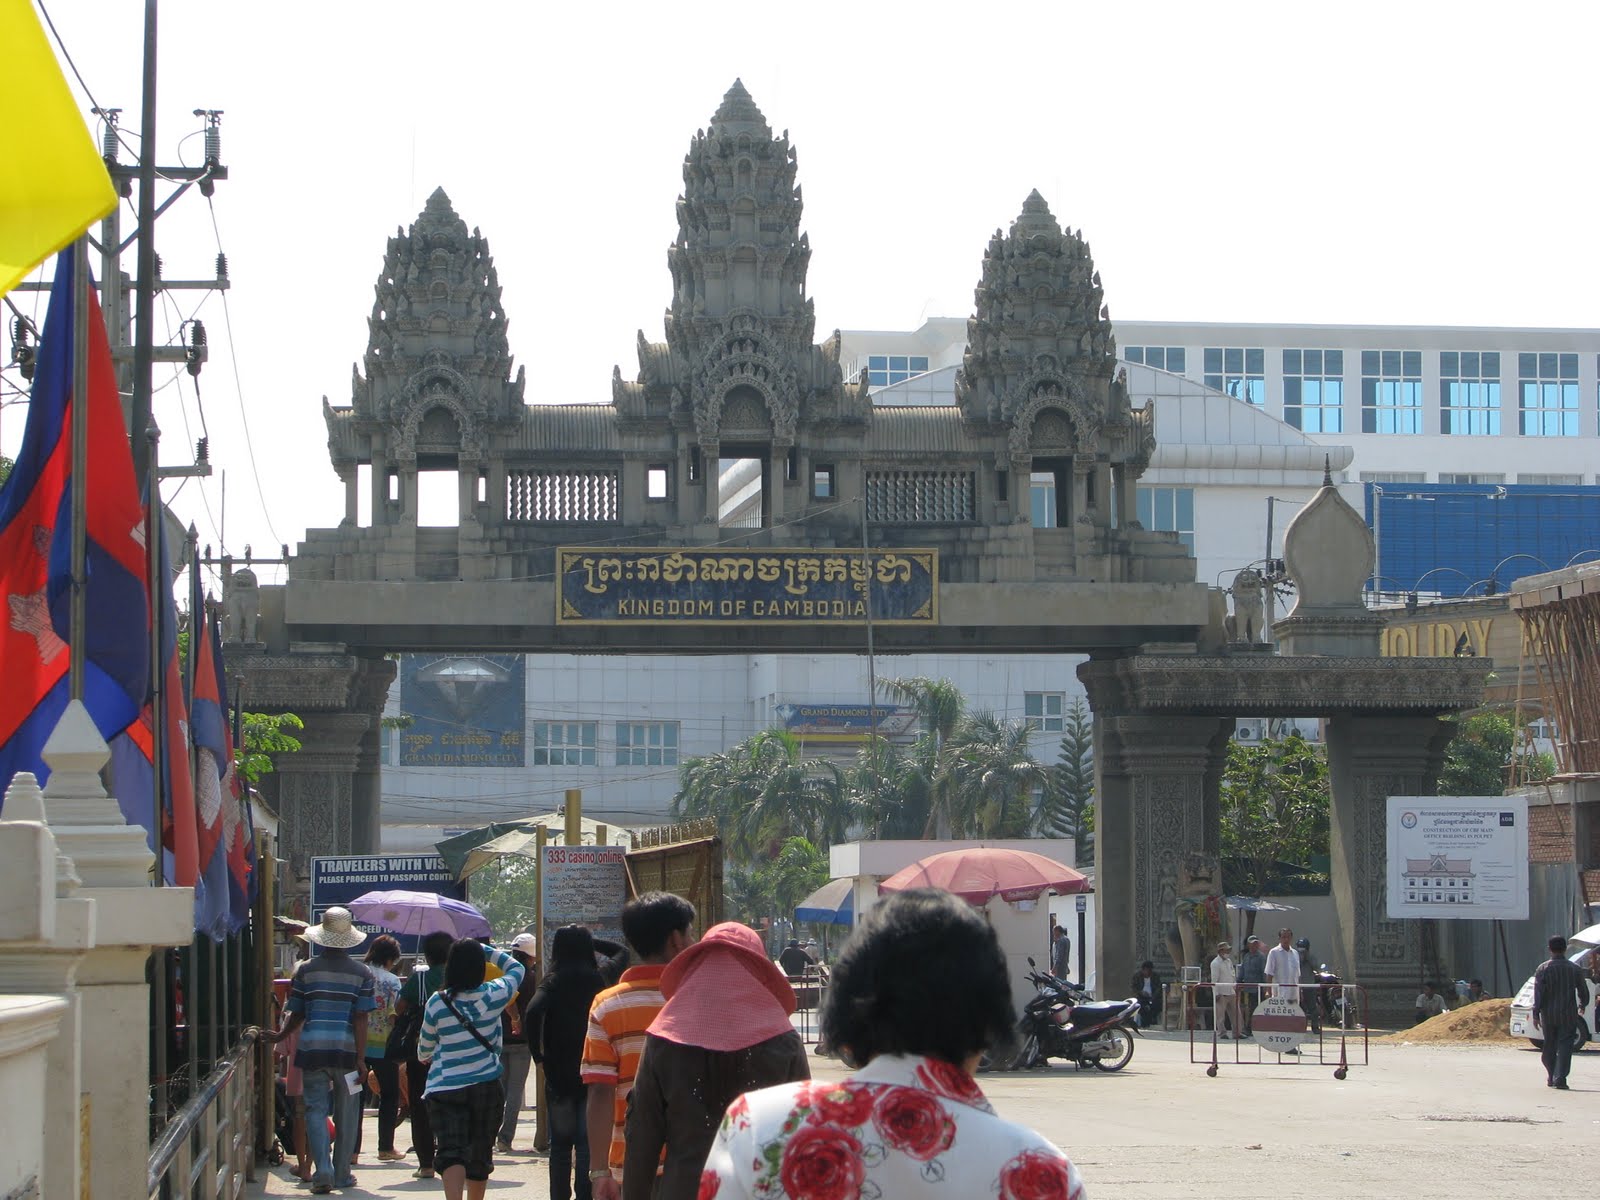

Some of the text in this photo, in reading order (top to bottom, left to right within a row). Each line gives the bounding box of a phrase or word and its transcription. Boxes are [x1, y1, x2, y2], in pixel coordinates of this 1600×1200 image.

[618, 600, 867, 616] KINGDOM OF CAMBODIA
[801, 708, 829, 717] GRAND
[831, 708, 868, 717] DIAMOND
[404, 753, 518, 762] GRAND DIAMOND CITY
[548, 849, 624, 864] 333 casino online
[319, 858, 448, 873] TRAVELERS WITH VIS
[319, 875, 345, 884] PLEASE
[346, 875, 378, 883] PROCEED
[380, 874, 389, 882] TO
[390, 873, 428, 882] PASSPORT
[356, 925, 382, 933] OCEED
